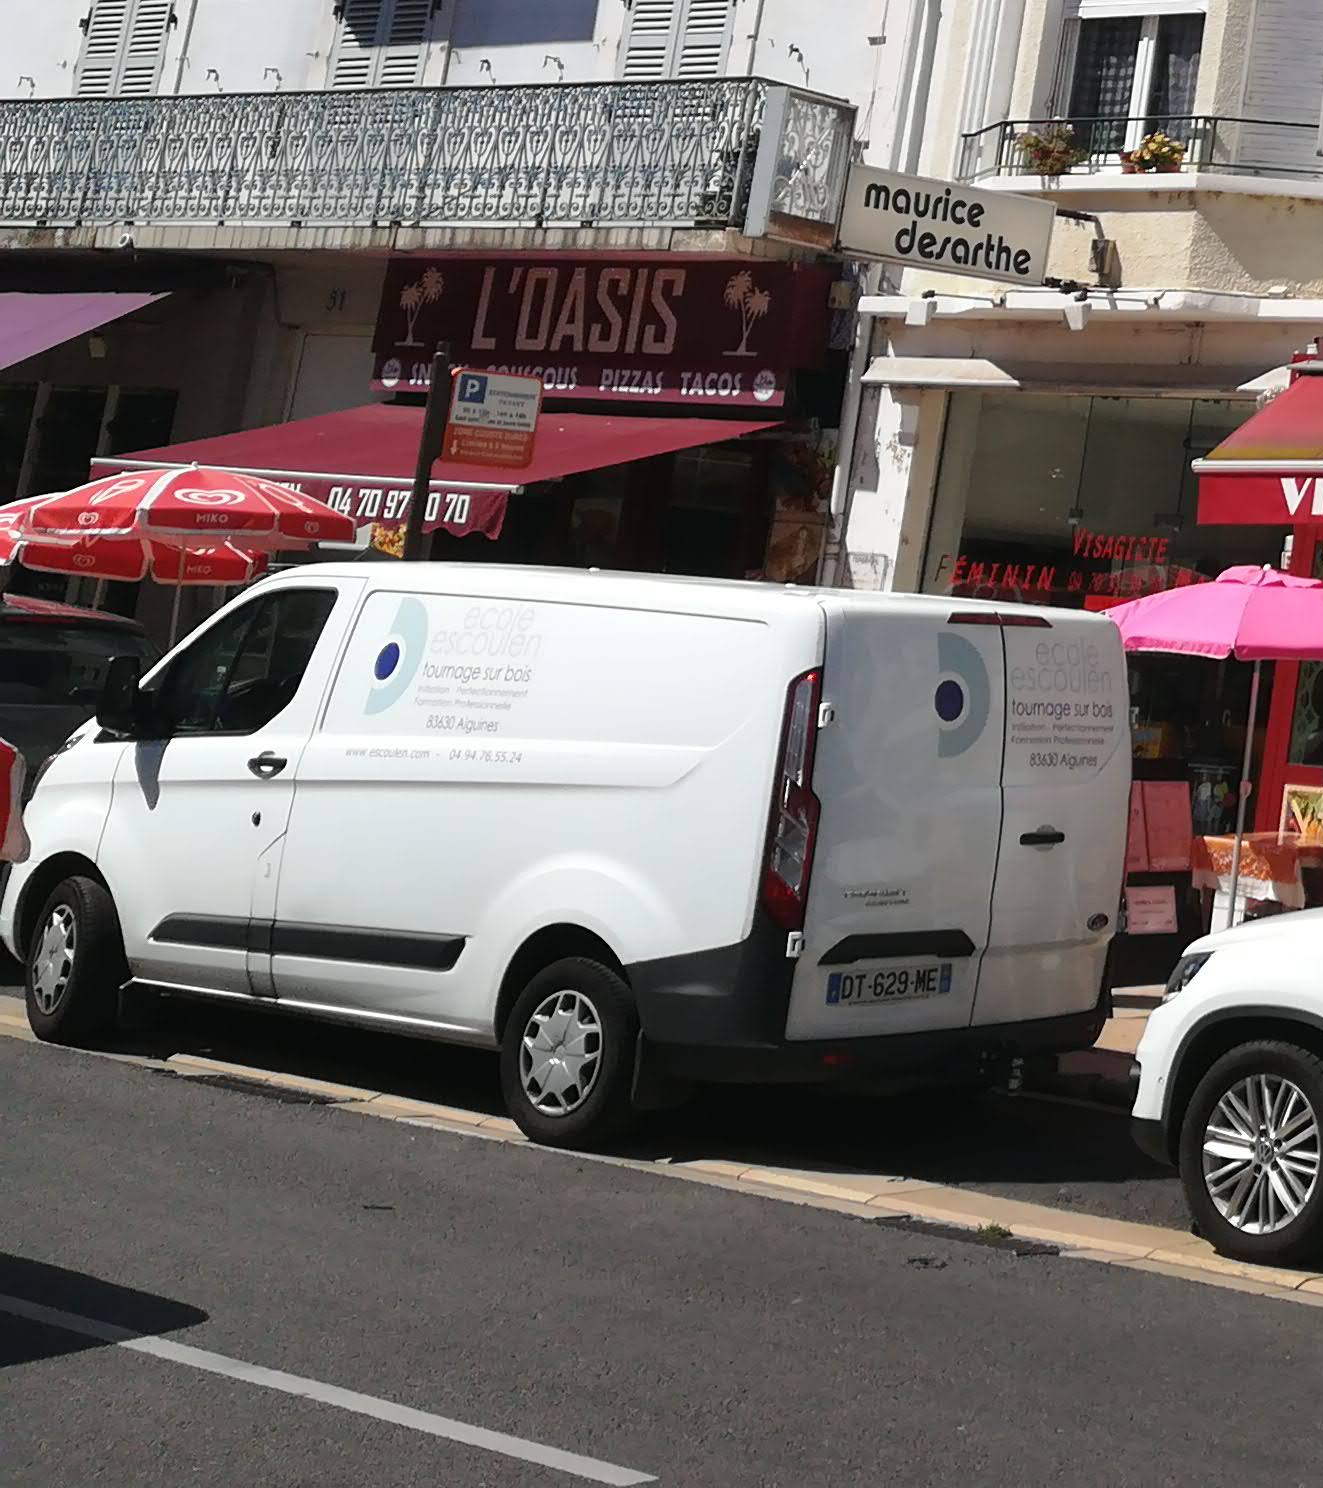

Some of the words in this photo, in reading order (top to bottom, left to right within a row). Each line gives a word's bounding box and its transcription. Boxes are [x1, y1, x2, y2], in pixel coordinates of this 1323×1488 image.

[864, 182, 985, 228] maurice
[894, 220, 1032, 276] desarthe
[472, 267, 687, 355] L'OASIS
[598, 368, 665, 395] PIZZAS
[680, 371, 743, 397] TACOS
[196, 513, 229, 524] MIKO
[327, 486, 352, 517] 04
[356, 488, 381, 518] 70
[383, 490, 411, 519] 97
[444, 493, 471, 524] 70
[186, 565, 212, 575] MIKO
[422, 662, 481, 683] tournage
[484, 667, 502, 681] sur
[504, 664, 532, 682] bois
[1010, 666, 1112, 693] escoulen
[1012, 698, 1071, 720] tournage
[1073, 703, 1090, 717] sur
[1092, 701, 1113, 718] bois
[425, 714, 455, 730] 83630
[456, 715, 499, 734] Aiguines
